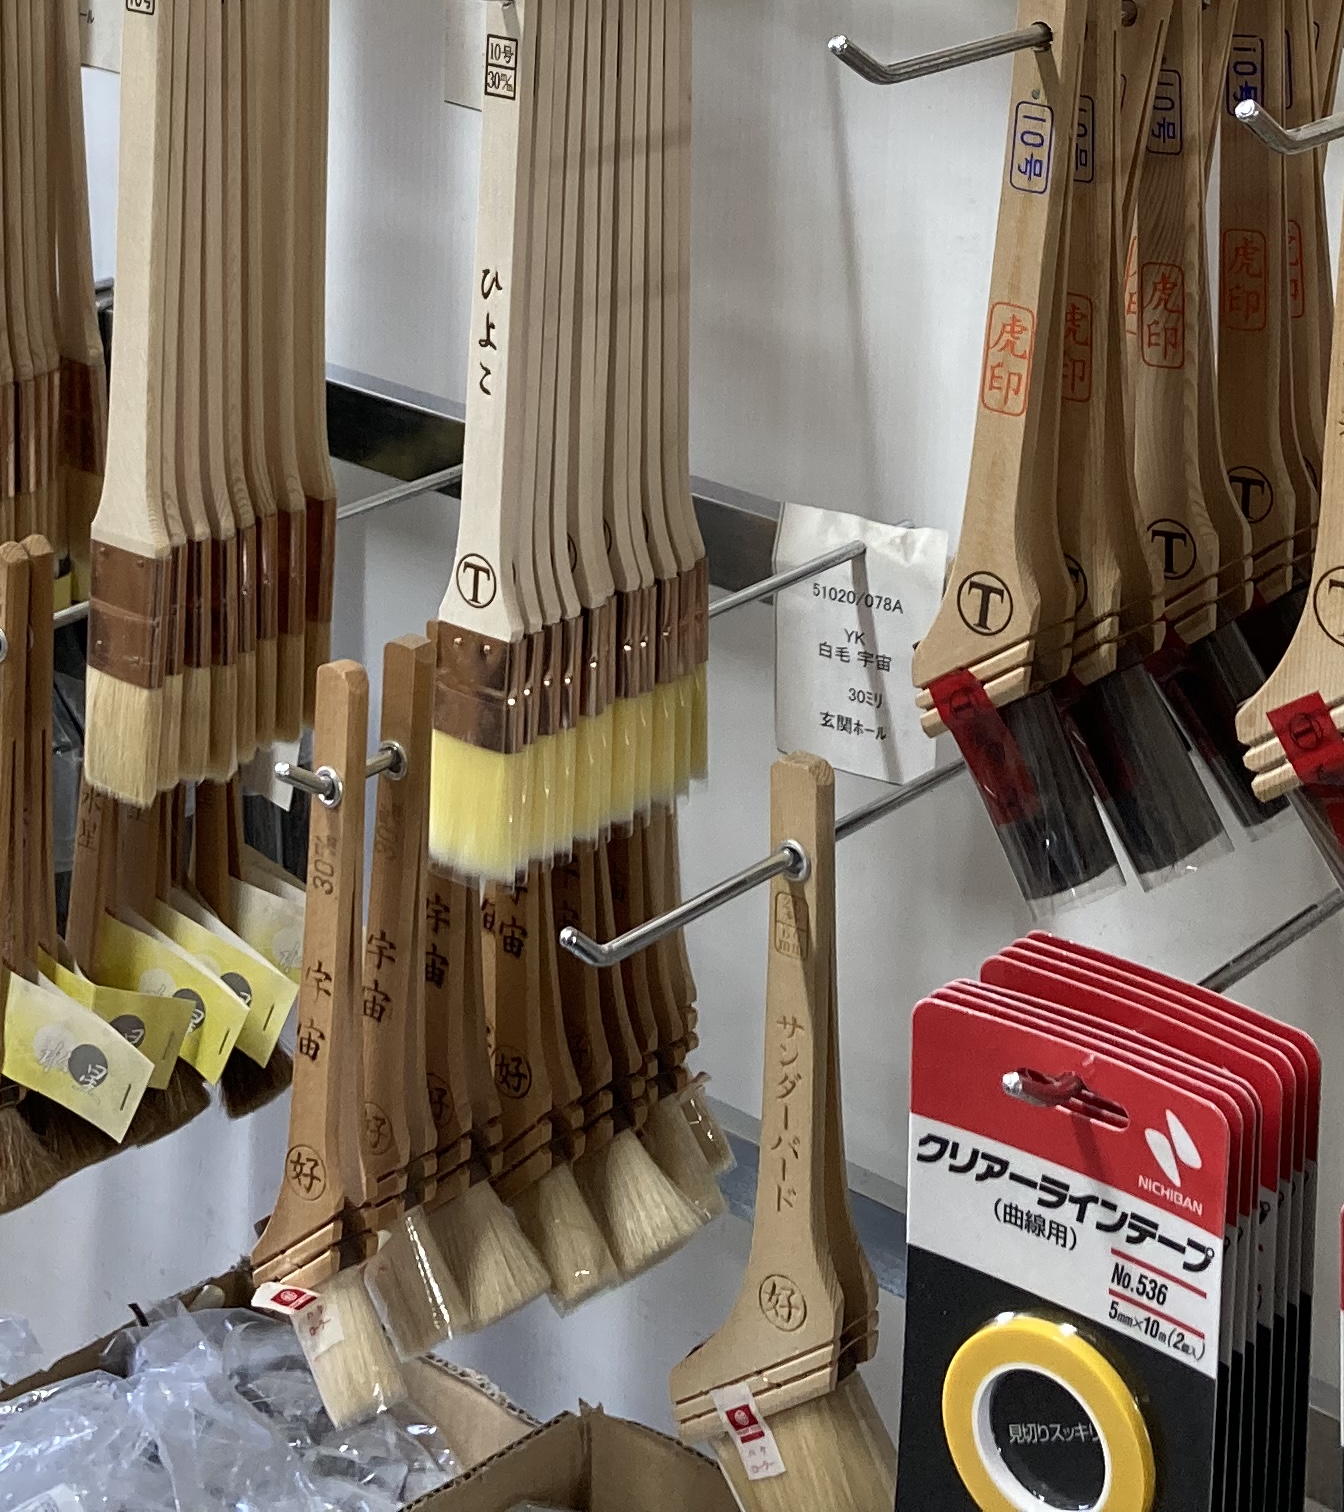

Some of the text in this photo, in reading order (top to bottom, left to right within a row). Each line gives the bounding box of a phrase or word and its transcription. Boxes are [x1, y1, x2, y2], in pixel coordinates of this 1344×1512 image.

[489, 41, 515, 65] 10号
[1018, 114, 1047, 182] 10号
[1229, 237, 1261, 322] 虎印
[478, 267, 503, 397] ひよこ
[1143, 273, 1182, 361] 虎印
[989, 315, 1030, 407] 虎印
[1228, 471, 1269, 522] T
[1149, 524, 1192, 577] T
[460, 557, 494, 606] T
[813, 582, 903, 614] 51020/078A
[963, 575, 1008, 633] T
[819, 641, 892, 672] 白毛 宇宙
[844, 628, 866, 646] YK
[848, 688, 883, 709] 30ミリ
[819, 711, 886, 740] 玄関ホール
[425, 892, 451, 989] 宇宙
[362, 929, 396, 1024] 宇宙
[296, 960, 333, 1062] 宇宙
[495, 1050, 529, 1096] 好
[288, 1148, 324, 1198] 好
[1137, 1175, 1203, 1217] NICHIBAN
[916, 1133, 1216, 1273] クリアーラインテープ
[993, 1197, 1078, 1251] (曲線用)
[761, 1277, 804, 1328] 好
[1111, 1262, 1168, 1307] No.536
